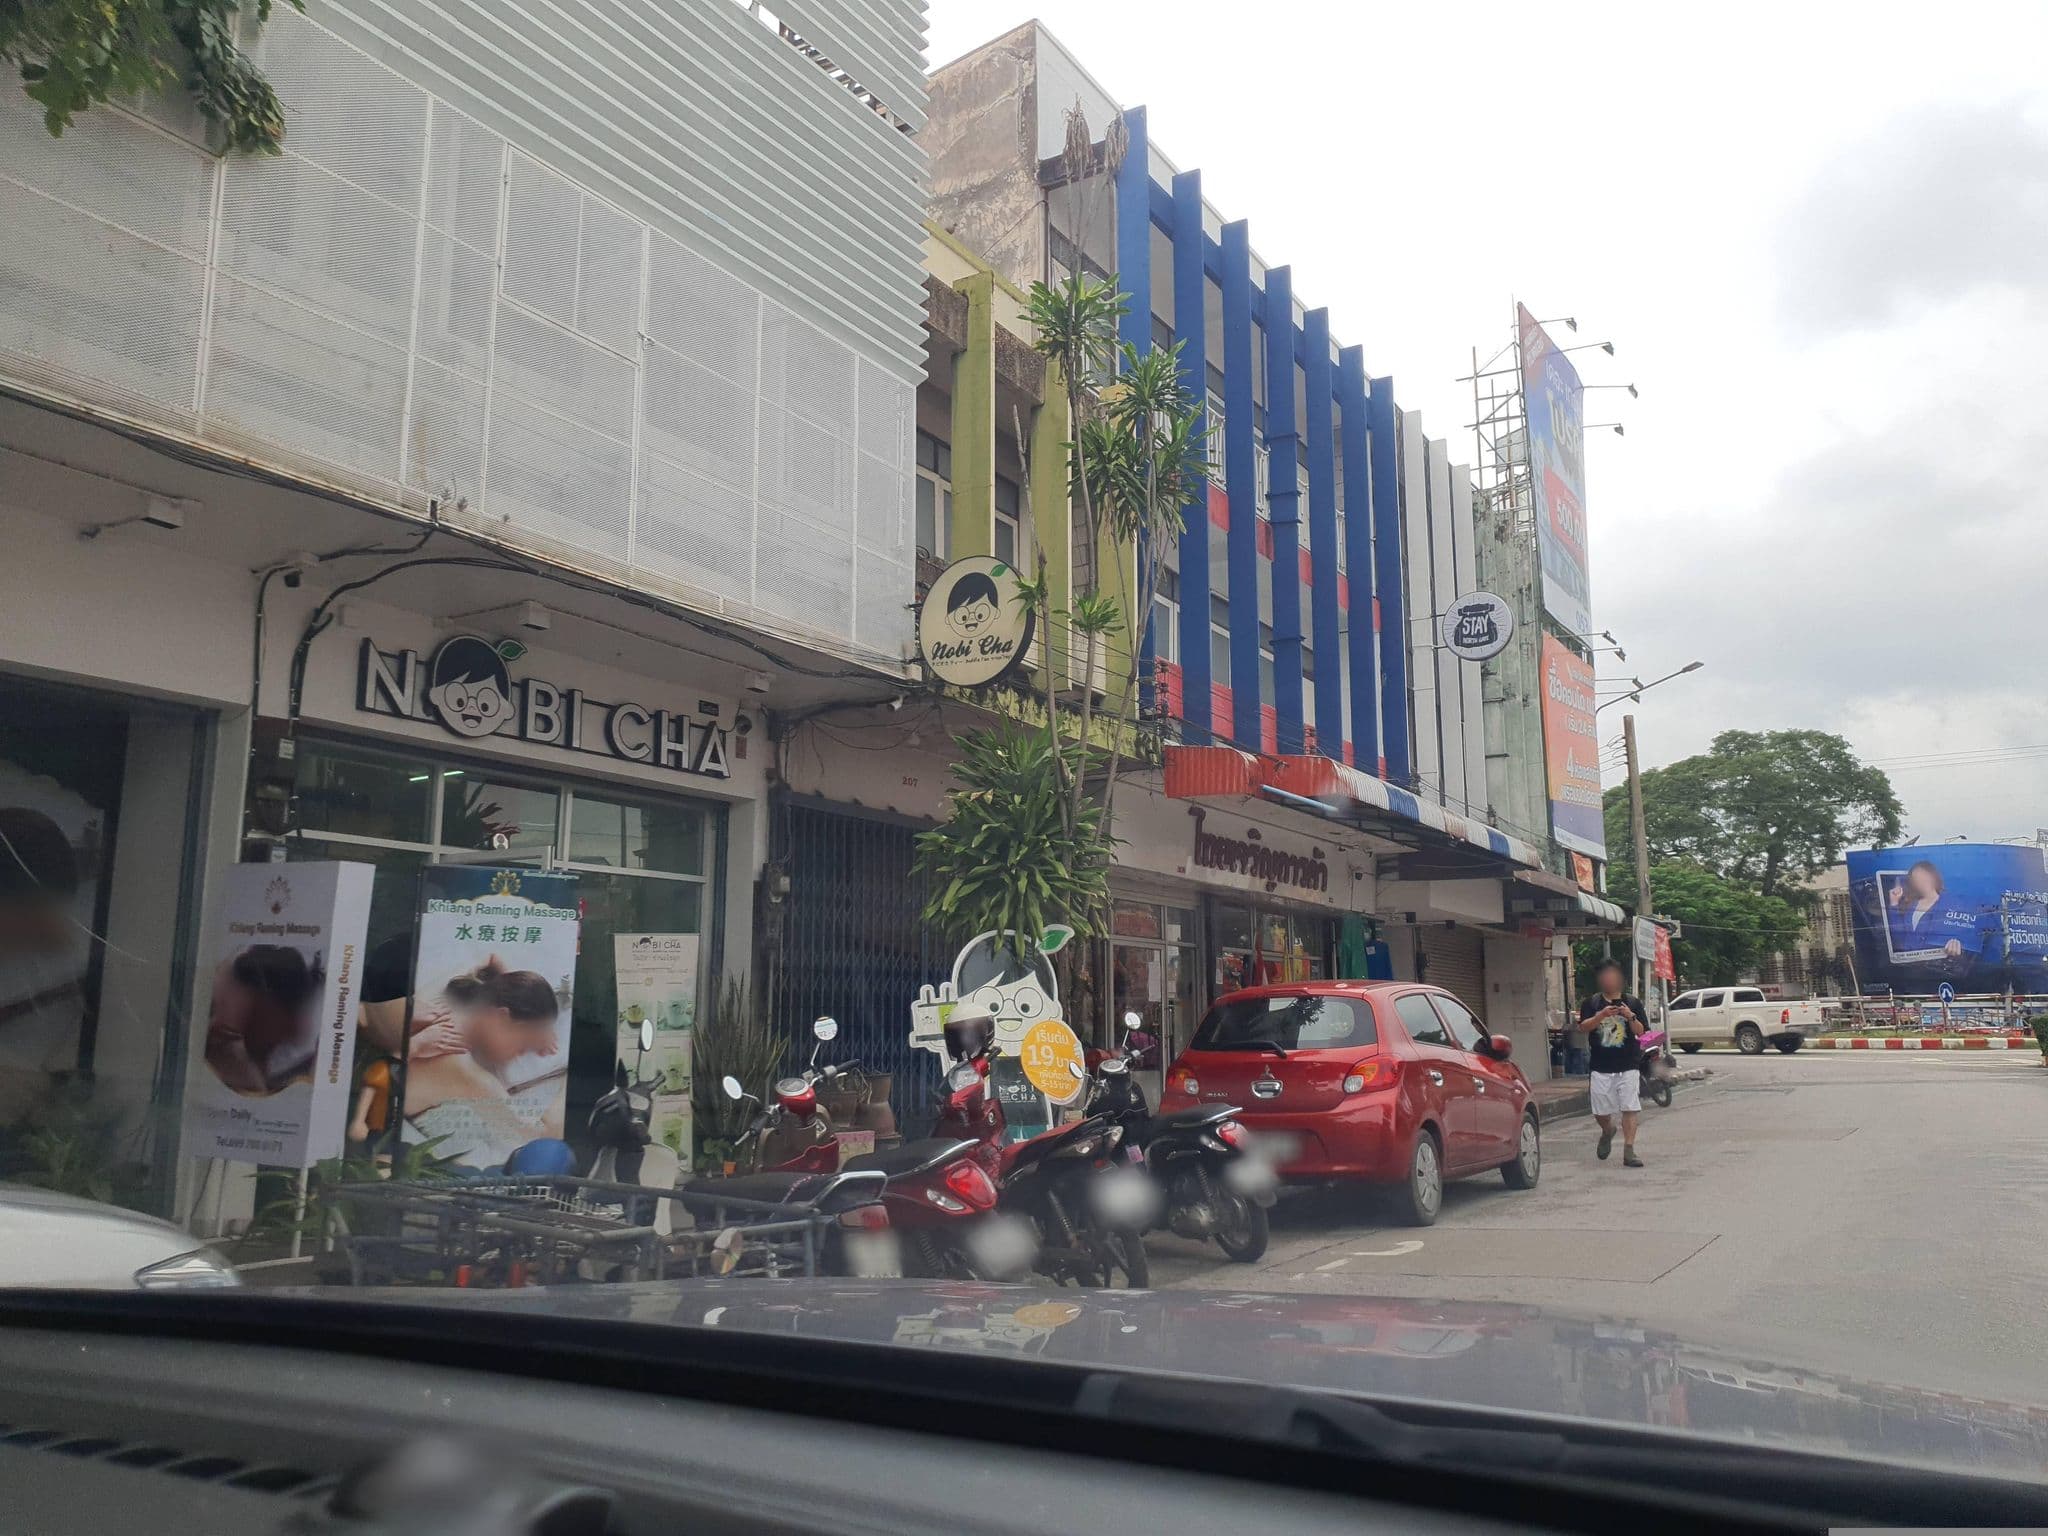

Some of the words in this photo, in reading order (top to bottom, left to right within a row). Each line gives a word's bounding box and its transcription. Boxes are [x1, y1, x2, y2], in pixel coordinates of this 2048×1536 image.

[1462, 613, 1488, 635] STAY
[931, 640, 973, 660] Nobi
[978, 635, 1014, 656] Cha
[607, 702, 731, 779] CHA
[428, 899, 471, 917] Khiang
[475, 902, 521, 919] Raming
[523, 906, 576, 921] Massage
[454, 923, 543, 944] 水療按摩
[1027, 1045, 1055, 1067] 19
